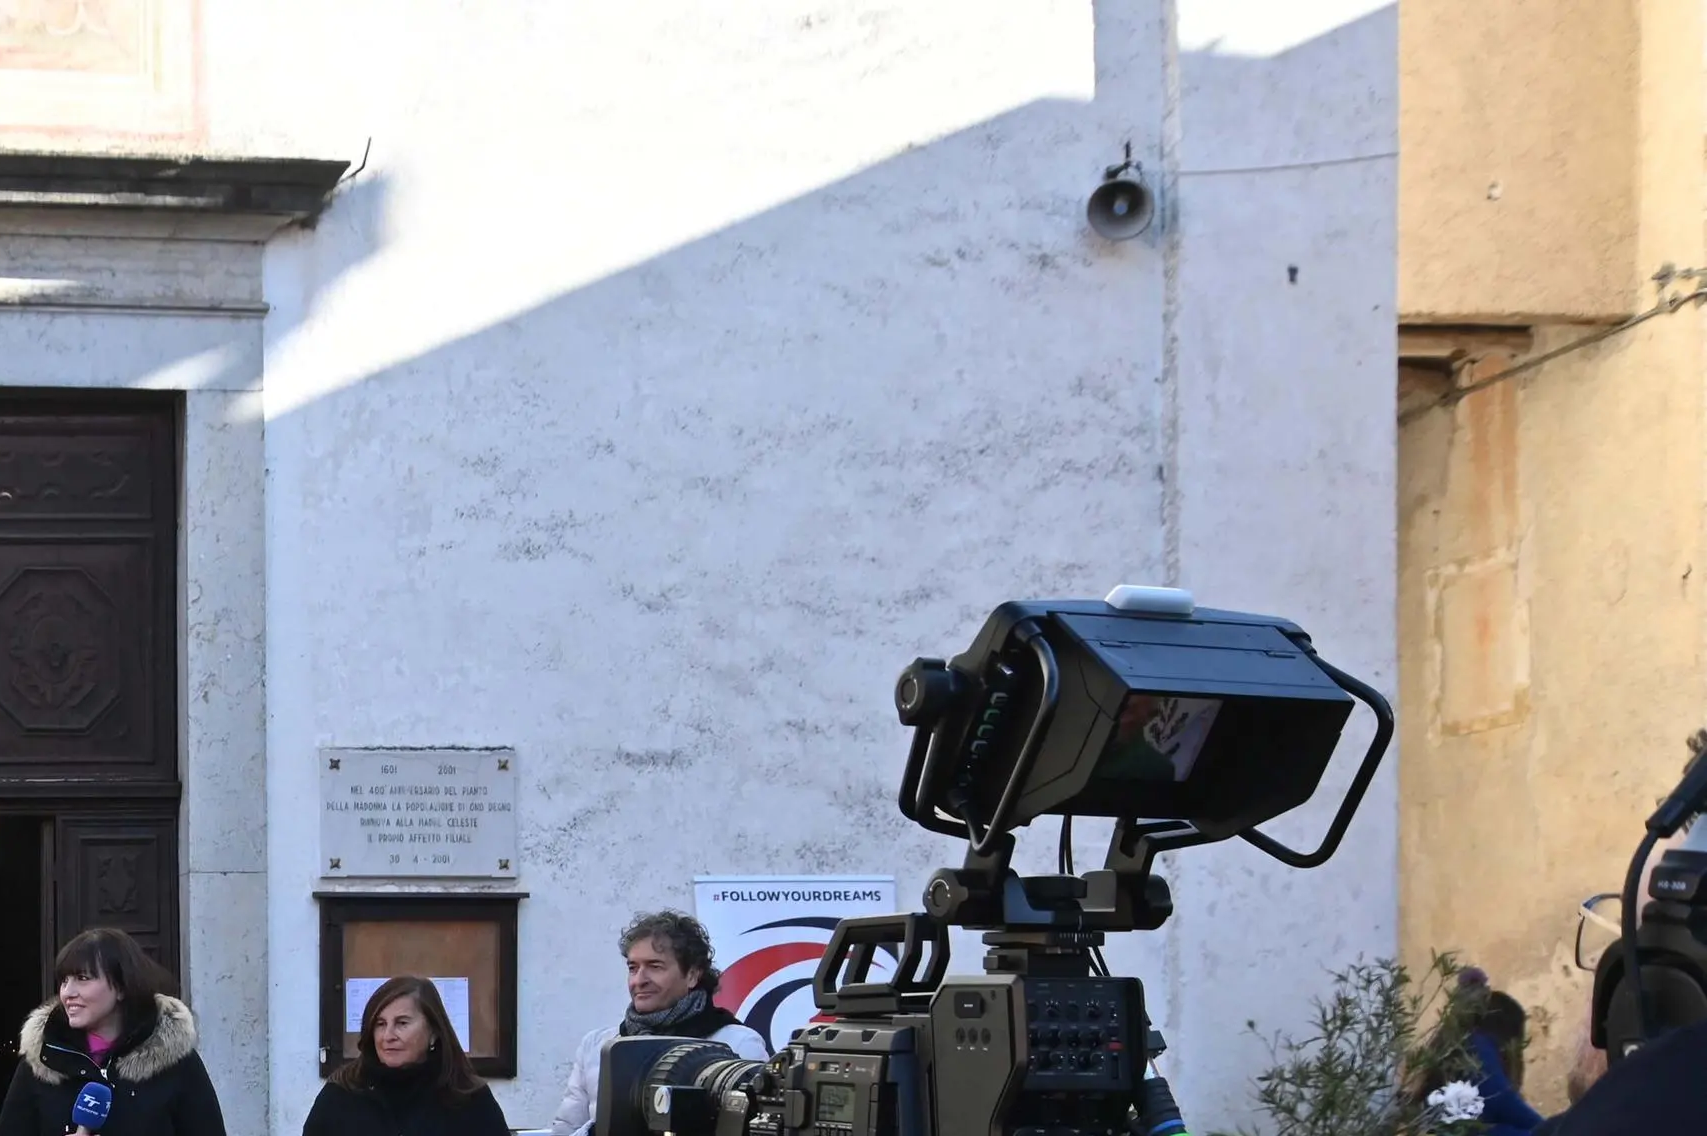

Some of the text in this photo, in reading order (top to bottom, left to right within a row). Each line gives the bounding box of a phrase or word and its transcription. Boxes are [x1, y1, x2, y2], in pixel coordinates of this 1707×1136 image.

[380, 764, 456, 775] 1601 2001
[350, 785, 365, 795] NEL
[443, 785, 457, 796] DEL
[462, 785, 488, 796] PIANTO
[326, 802, 349, 812] DELLA
[353, 802, 387, 812] MADONNA
[391, 802, 402, 812] LA
[457, 803, 465, 812] DI
[395, 817, 414, 827] ALLA
[446, 817, 478, 828] CELESTE
[408, 833, 441, 844] AFFETTO
[389, 854, 400, 864] 30
[432, 854, 451, 864] 2001
[713, 890, 882, 902] #FOLLOWYOURDREAMS
